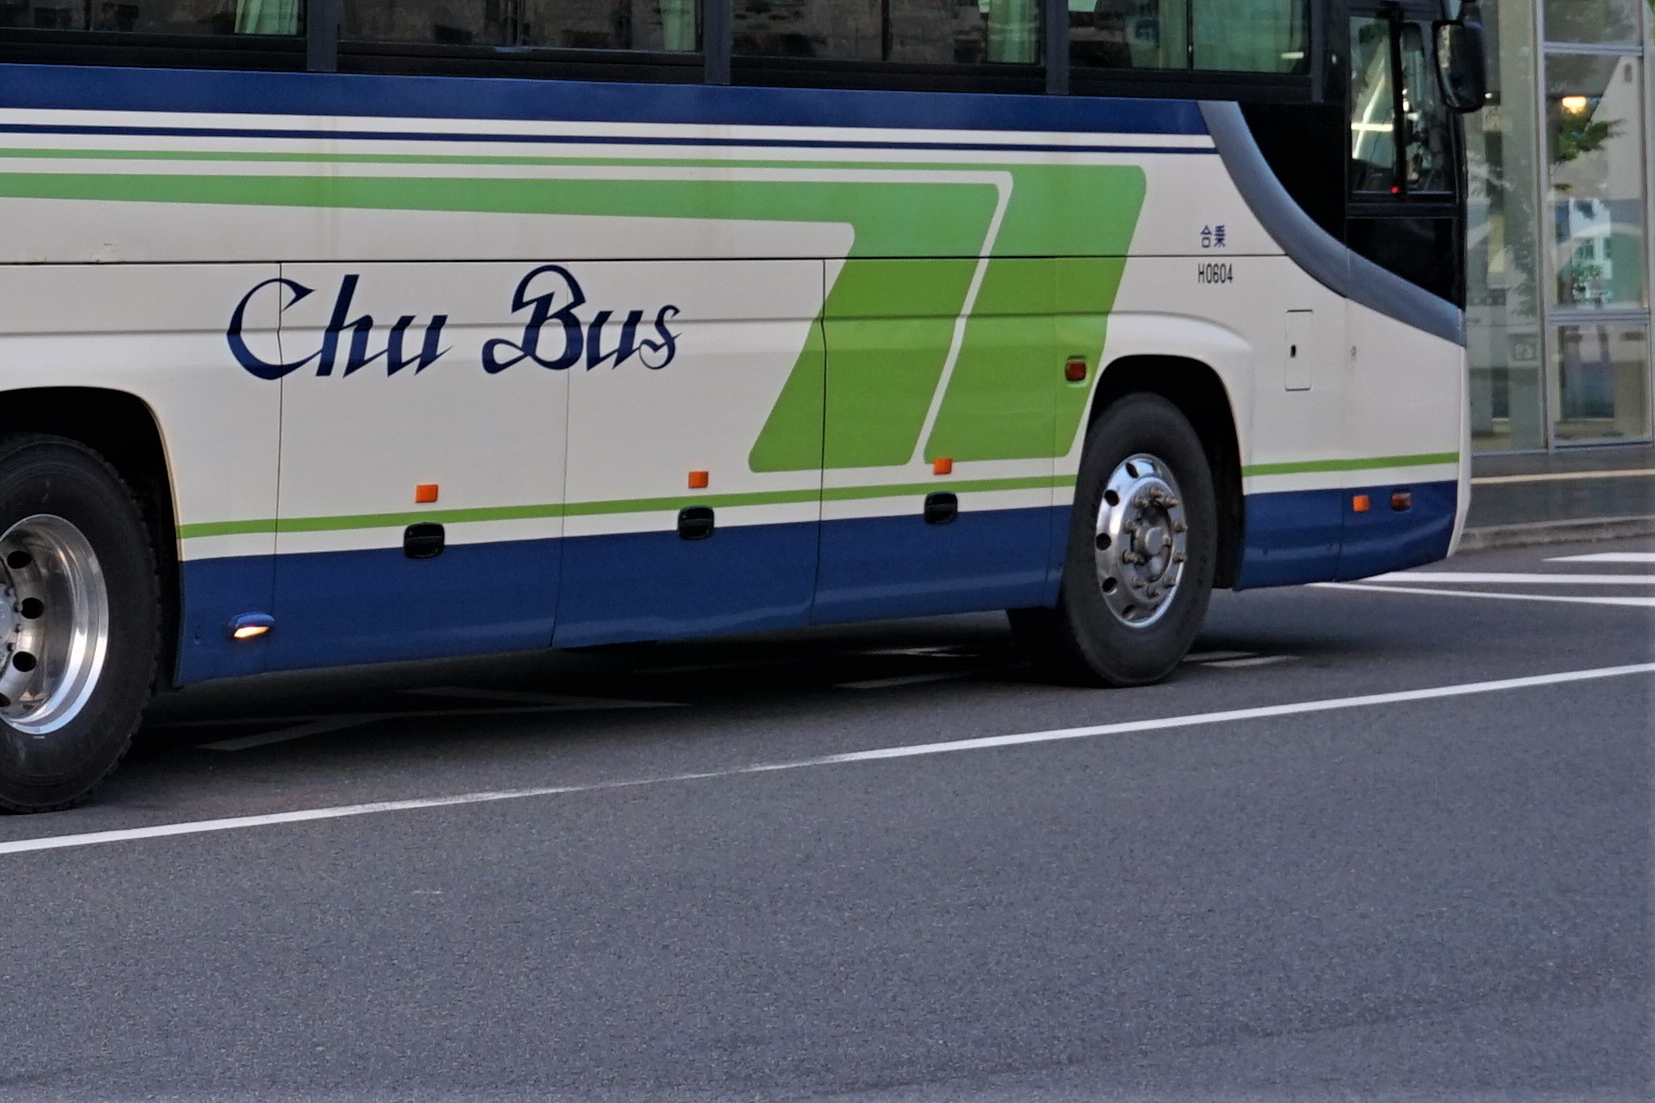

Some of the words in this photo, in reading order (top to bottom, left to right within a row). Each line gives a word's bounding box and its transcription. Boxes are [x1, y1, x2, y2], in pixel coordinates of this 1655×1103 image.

[1198, 263, 1233, 284] H0604
[227, 274, 453, 380] Chu
[481, 264, 682, 374] Bus
